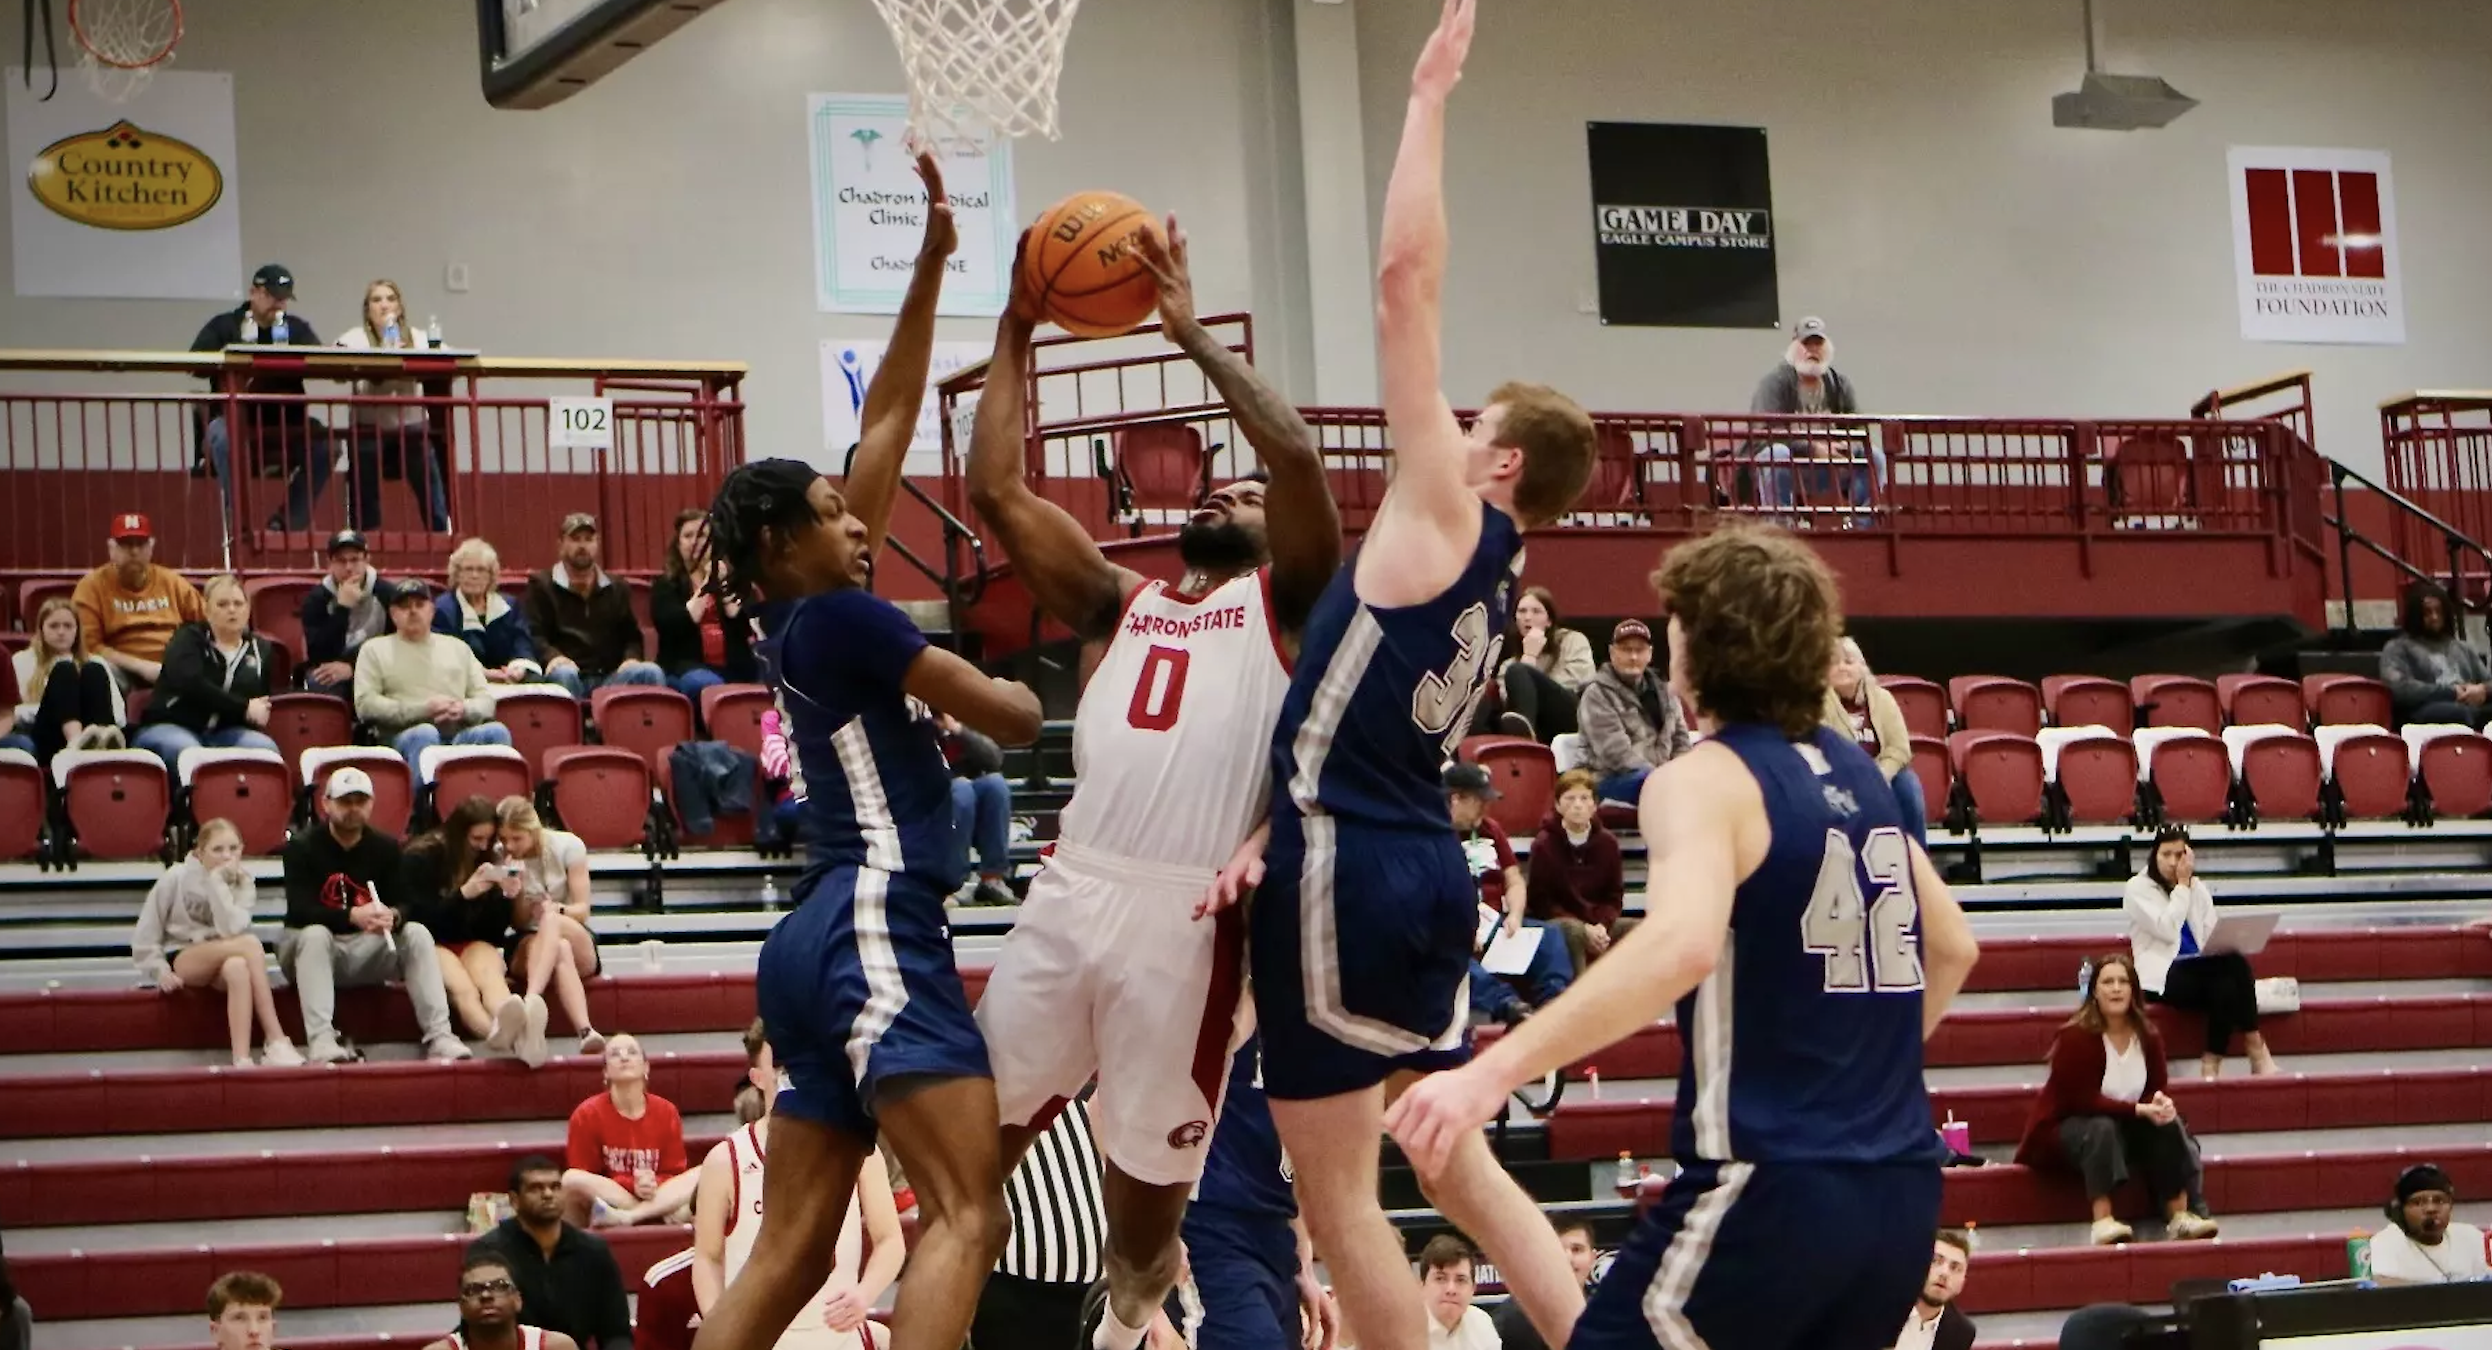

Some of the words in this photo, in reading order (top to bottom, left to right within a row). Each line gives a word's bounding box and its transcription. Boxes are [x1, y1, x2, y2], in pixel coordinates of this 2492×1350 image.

[59, 152, 192, 182] Country
[67, 179, 187, 205] Kitchen
[839, 187, 915, 205] Chadron
[922, 190, 990, 208] Mdical
[1603, 207, 1682, 233] GAME
[1700, 210, 1752, 235] DAY
[1601, 233, 1650, 245] EAGLE
[1655, 235, 1716, 247] CAMPUS
[1720, 237, 1769, 249] STORE
[871, 256, 914, 271] Chadr
[2257, 283, 2277, 294] THE
[2284, 283, 2347, 295] CHADRON
[2256, 299, 2388, 317] FOUNDATION
[562, 408, 606, 430] 102
[957, 411, 974, 437] 10
[1191, 606, 1246, 636] STATE
[1127, 644, 1190, 732] 0
[1801, 827, 1925, 993] 42
